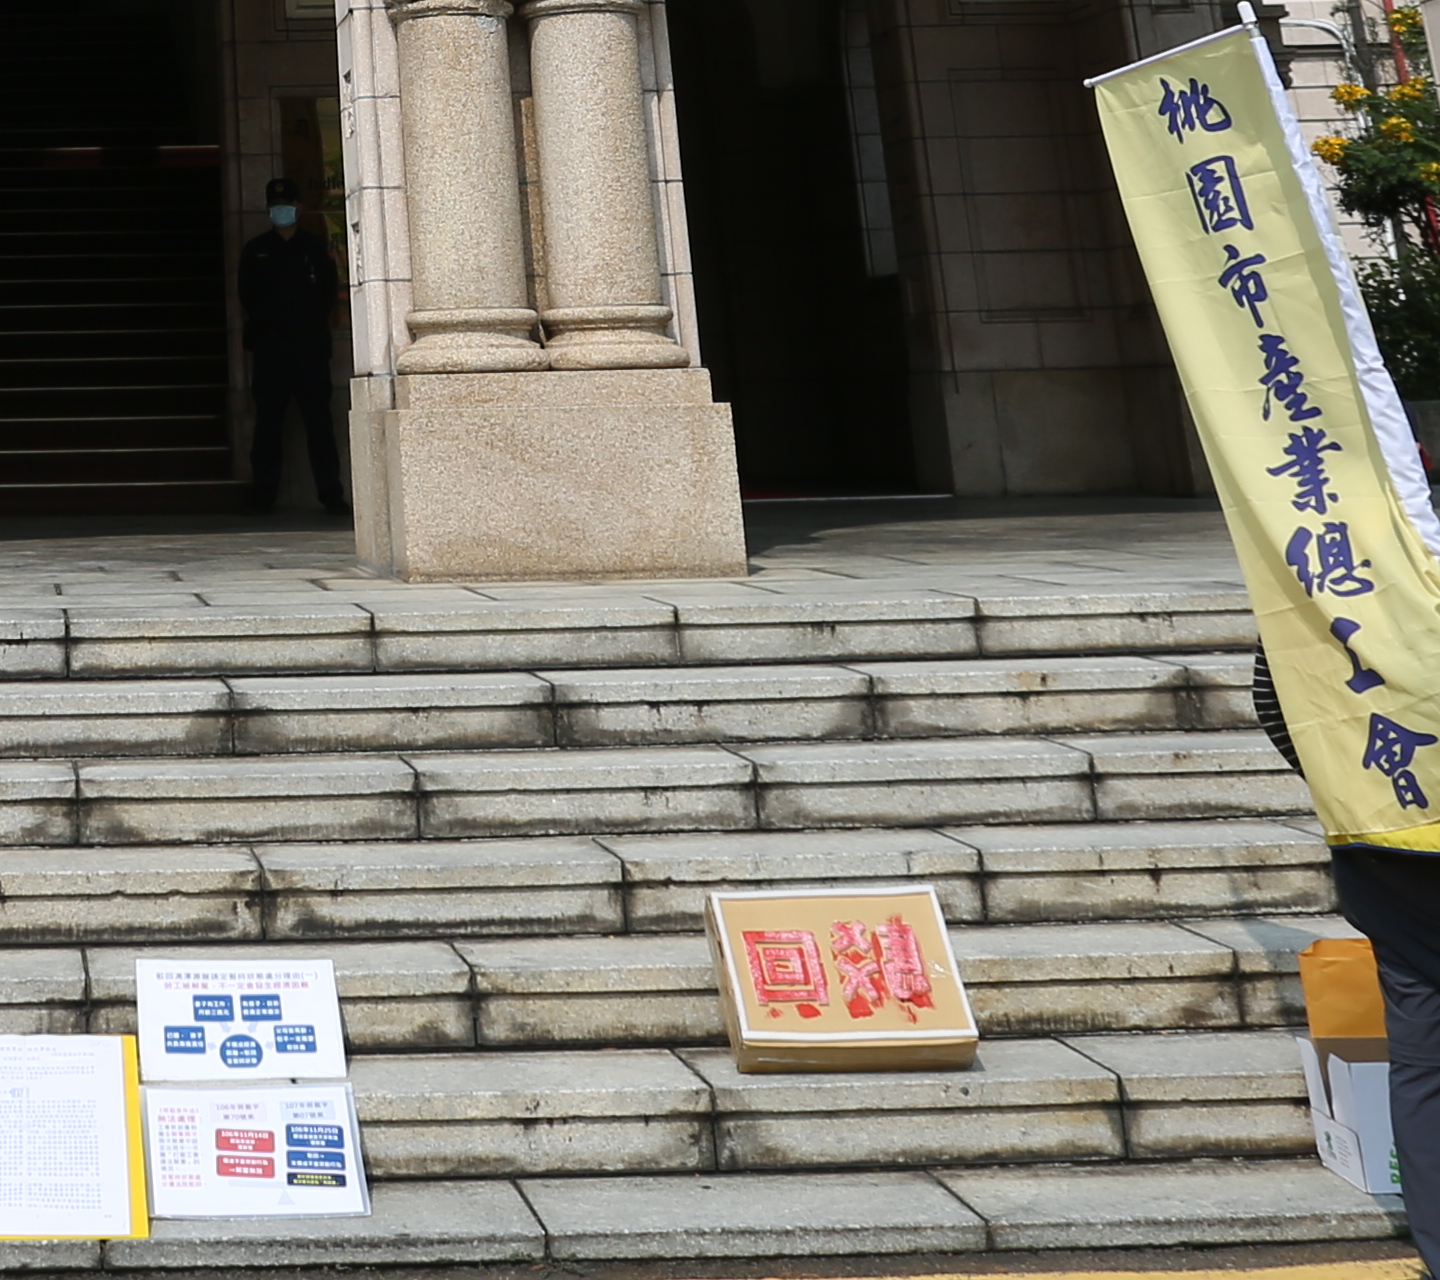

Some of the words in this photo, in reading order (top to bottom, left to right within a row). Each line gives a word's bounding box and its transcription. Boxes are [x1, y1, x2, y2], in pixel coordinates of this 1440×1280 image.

[1156, 74, 1439, 811] 桃園市產業總工會
